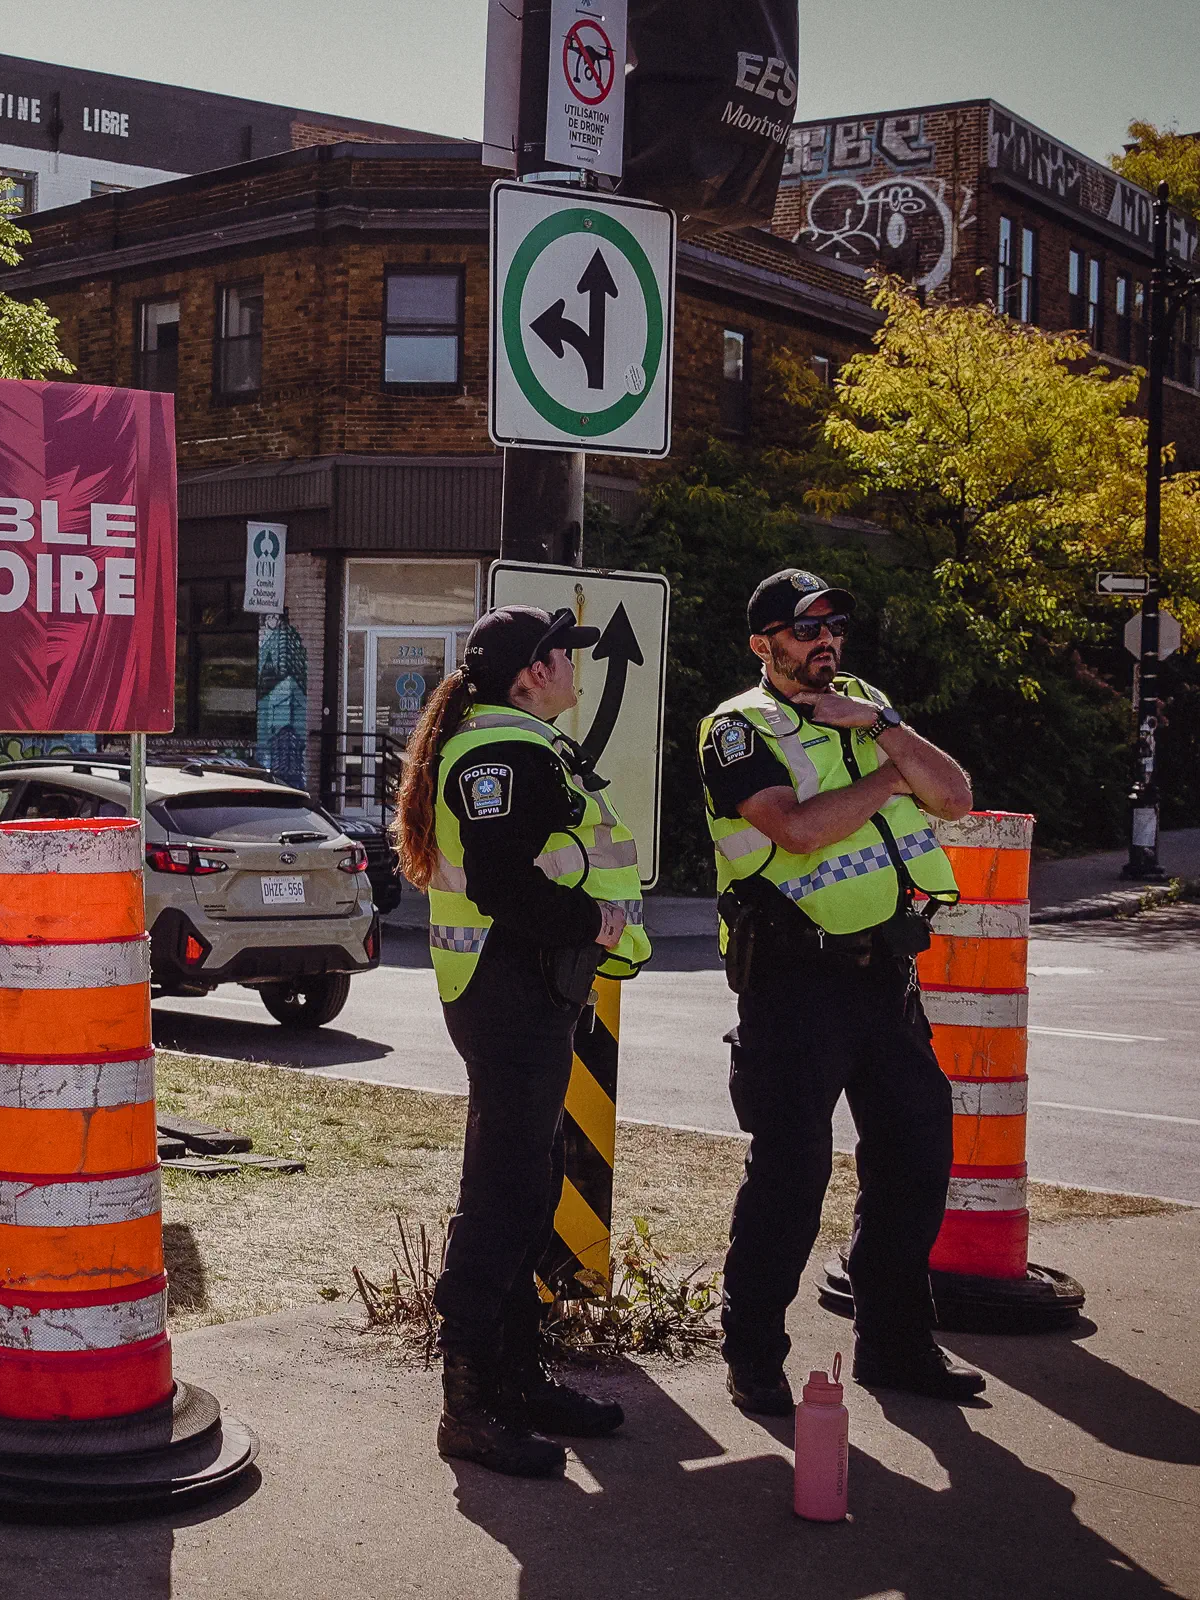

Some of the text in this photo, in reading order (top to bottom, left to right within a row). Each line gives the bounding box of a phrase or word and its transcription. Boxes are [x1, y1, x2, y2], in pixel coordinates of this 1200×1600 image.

[564, 103, 610, 124] UTILISATION
[83, 107, 129, 138] LIBRE
[568, 117, 605, 135] DE DRONE
[721, 101, 789, 145] Montréal
[569, 130, 603, 147] INTERDIT
[256, 579, 274, 588] Comité
[248, 597, 256, 606] de
[252, 588, 276, 600] Chômage
[399, 646, 424, 657] 3734
[466, 647, 484, 655] LICE
[715, 720, 750, 736] POLICE
[726, 750, 745, 762] SPVM
[464, 767, 508, 782] POLICE
[477, 807, 500, 816] SPVM
[836, 1432, 847, 1497] lululemon
